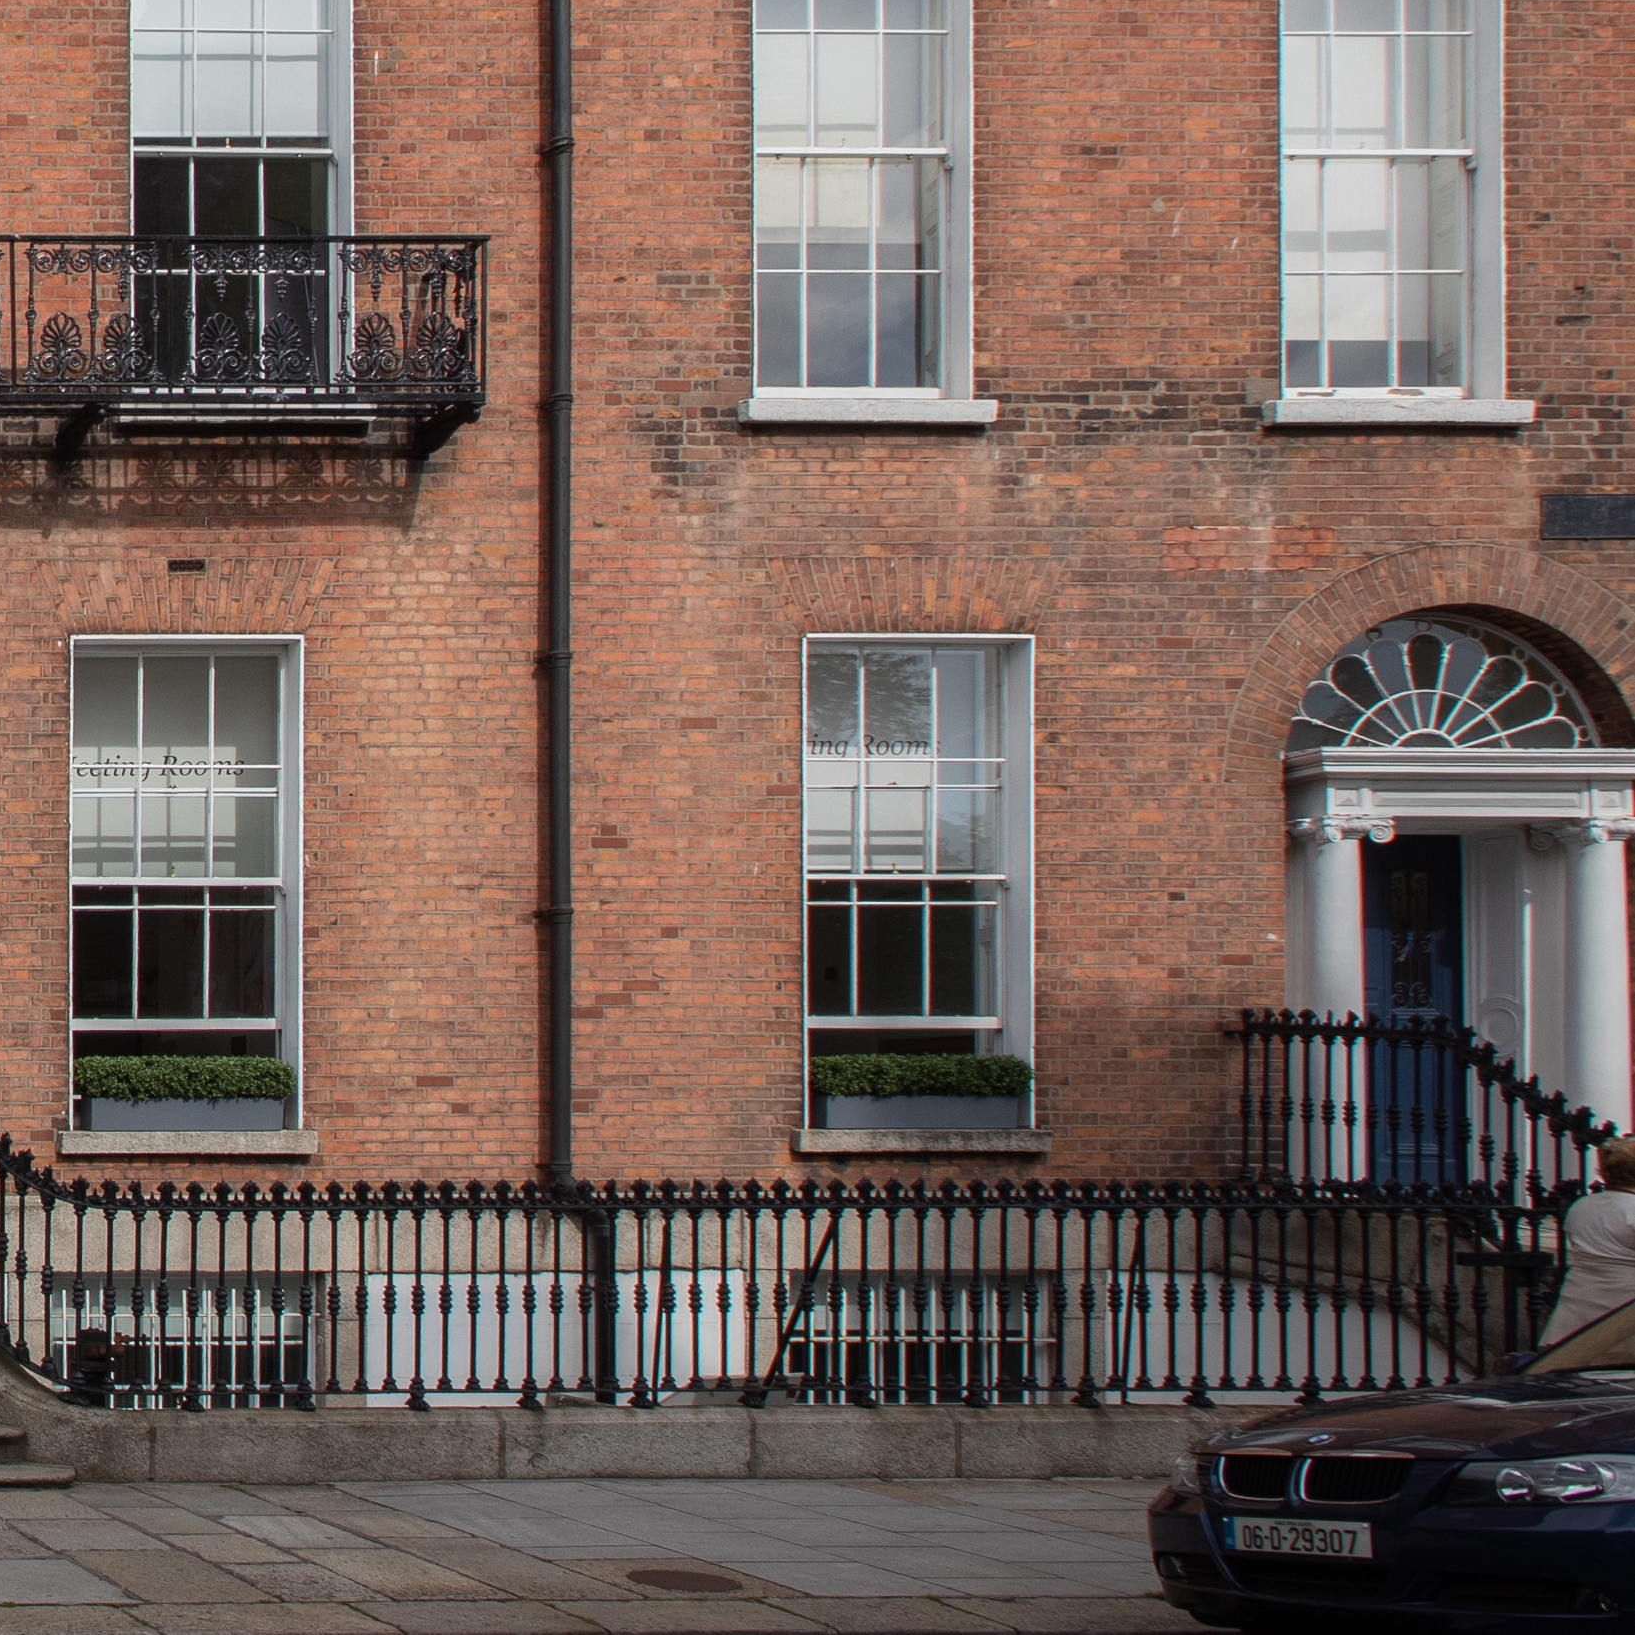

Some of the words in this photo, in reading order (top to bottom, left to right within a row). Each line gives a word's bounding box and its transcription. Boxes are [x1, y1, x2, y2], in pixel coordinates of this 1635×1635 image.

[856, 734, 941, 755] Room
[72, 755, 151, 782] eeting
[159, 755, 245, 776] Rooms
[1242, 1525, 1357, 1555] 06-D-29307
